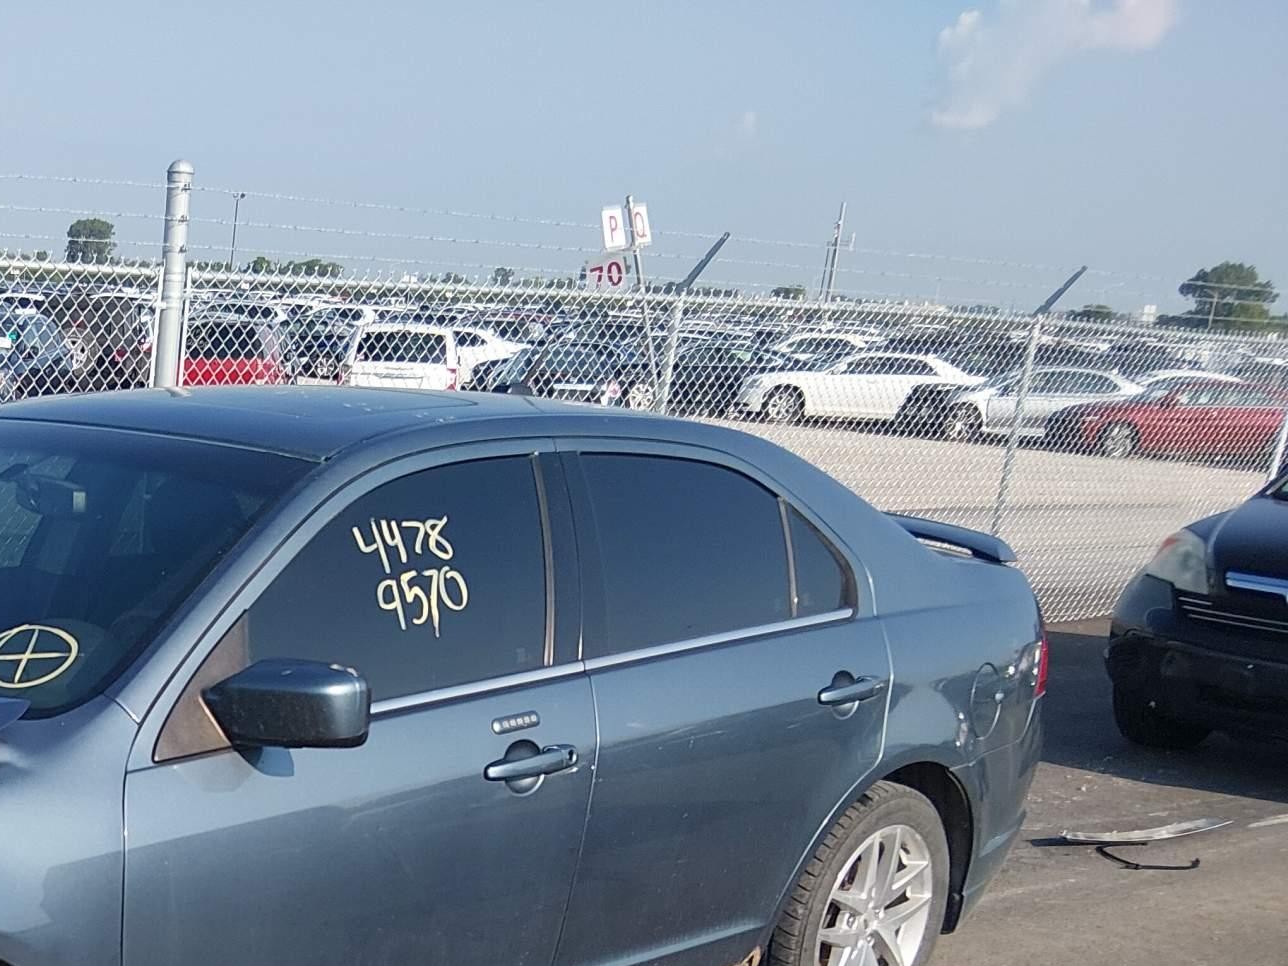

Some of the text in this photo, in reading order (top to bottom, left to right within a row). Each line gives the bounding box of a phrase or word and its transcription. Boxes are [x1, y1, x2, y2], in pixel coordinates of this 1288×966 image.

[609, 215, 618, 243] P
[634, 212, 647, 238] Q
[589, 261, 623, 289] 70
[352, 515, 454, 574] 4478
[376, 566, 469, 638] 9570
